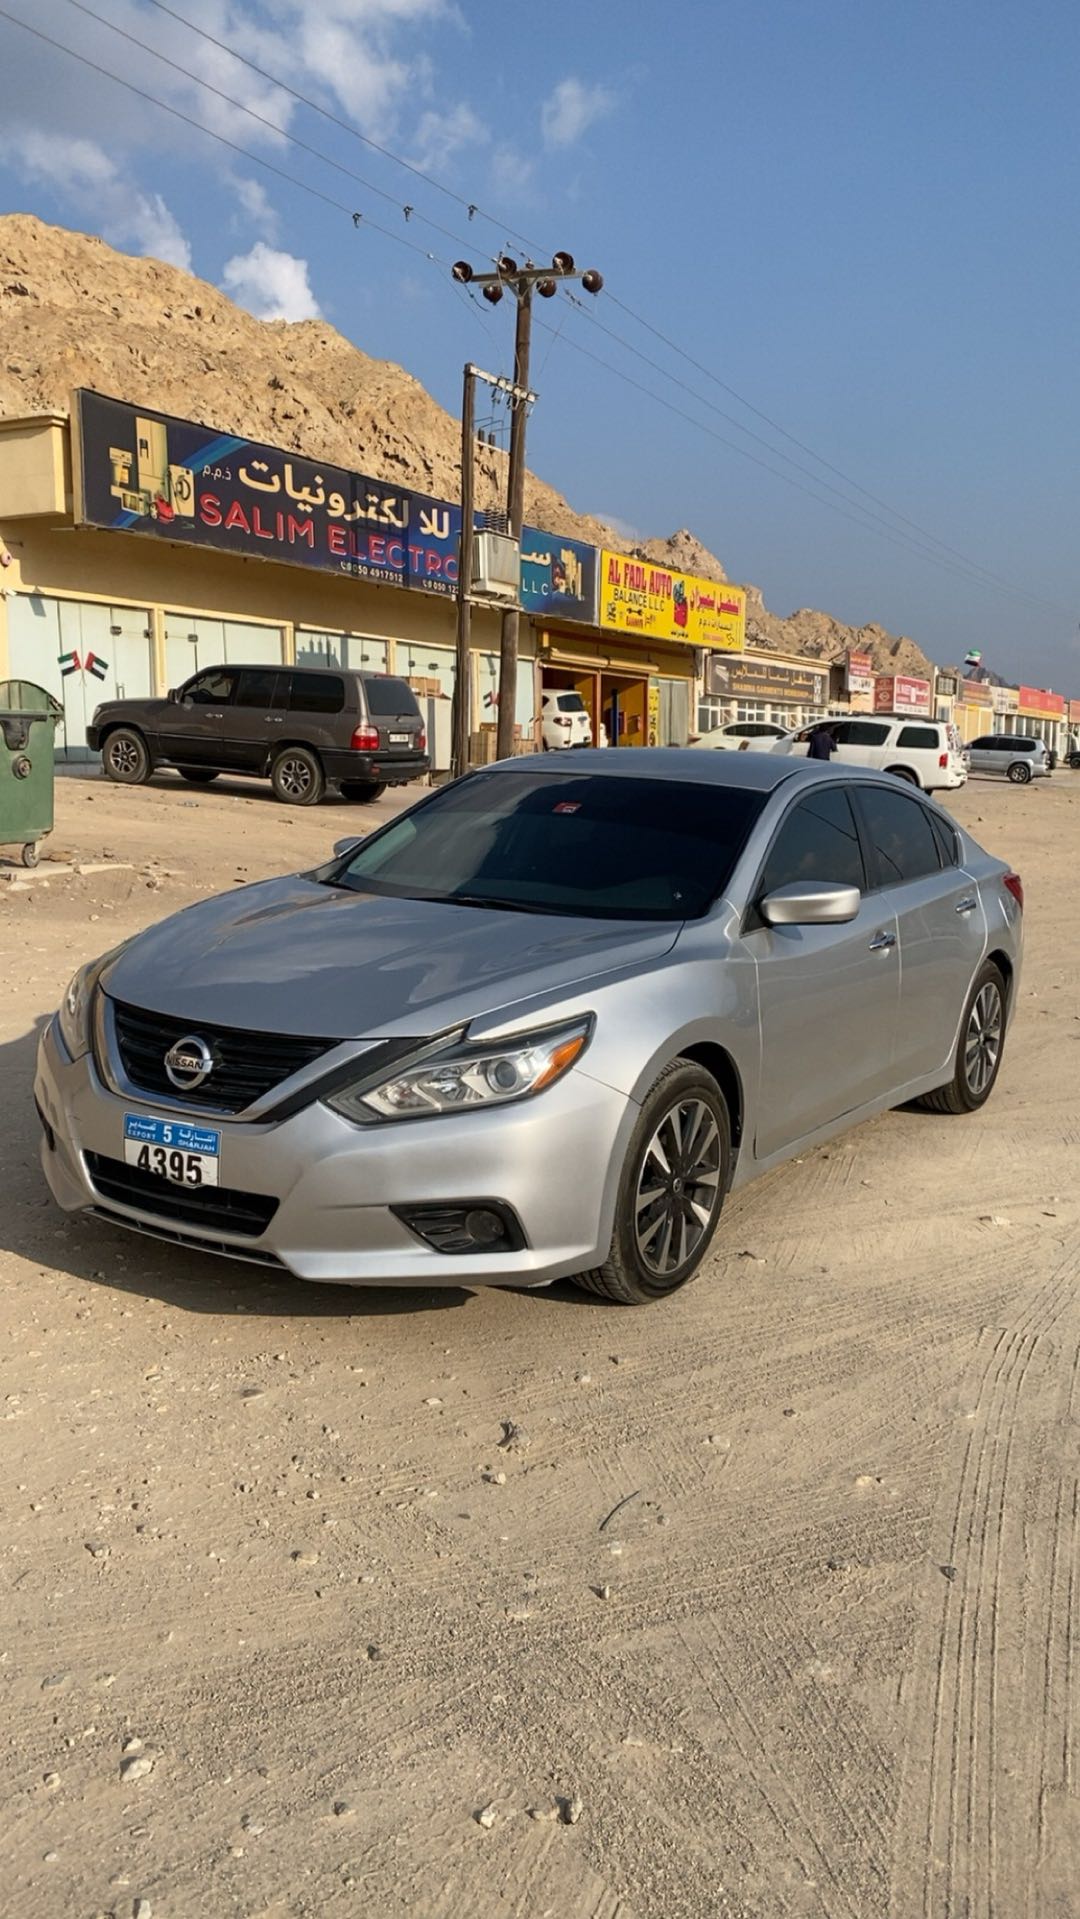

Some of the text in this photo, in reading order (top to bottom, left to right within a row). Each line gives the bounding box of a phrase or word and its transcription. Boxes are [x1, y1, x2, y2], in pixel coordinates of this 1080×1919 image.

[200, 490, 549, 597] SALIM ELECTRO LLC
[352, 564, 368, 576] 050
[608, 558, 673, 600] AL FADL AUTO
[433, 581, 446, 592] 050
[613, 587, 648, 609] BALANCE
[167, 1053, 204, 1070] NISSAN
[127, 1129, 216, 1152] EXPORT SHARJAH
[163, 1125, 173, 1143] 5
[137, 1144, 202, 1185] 4395
